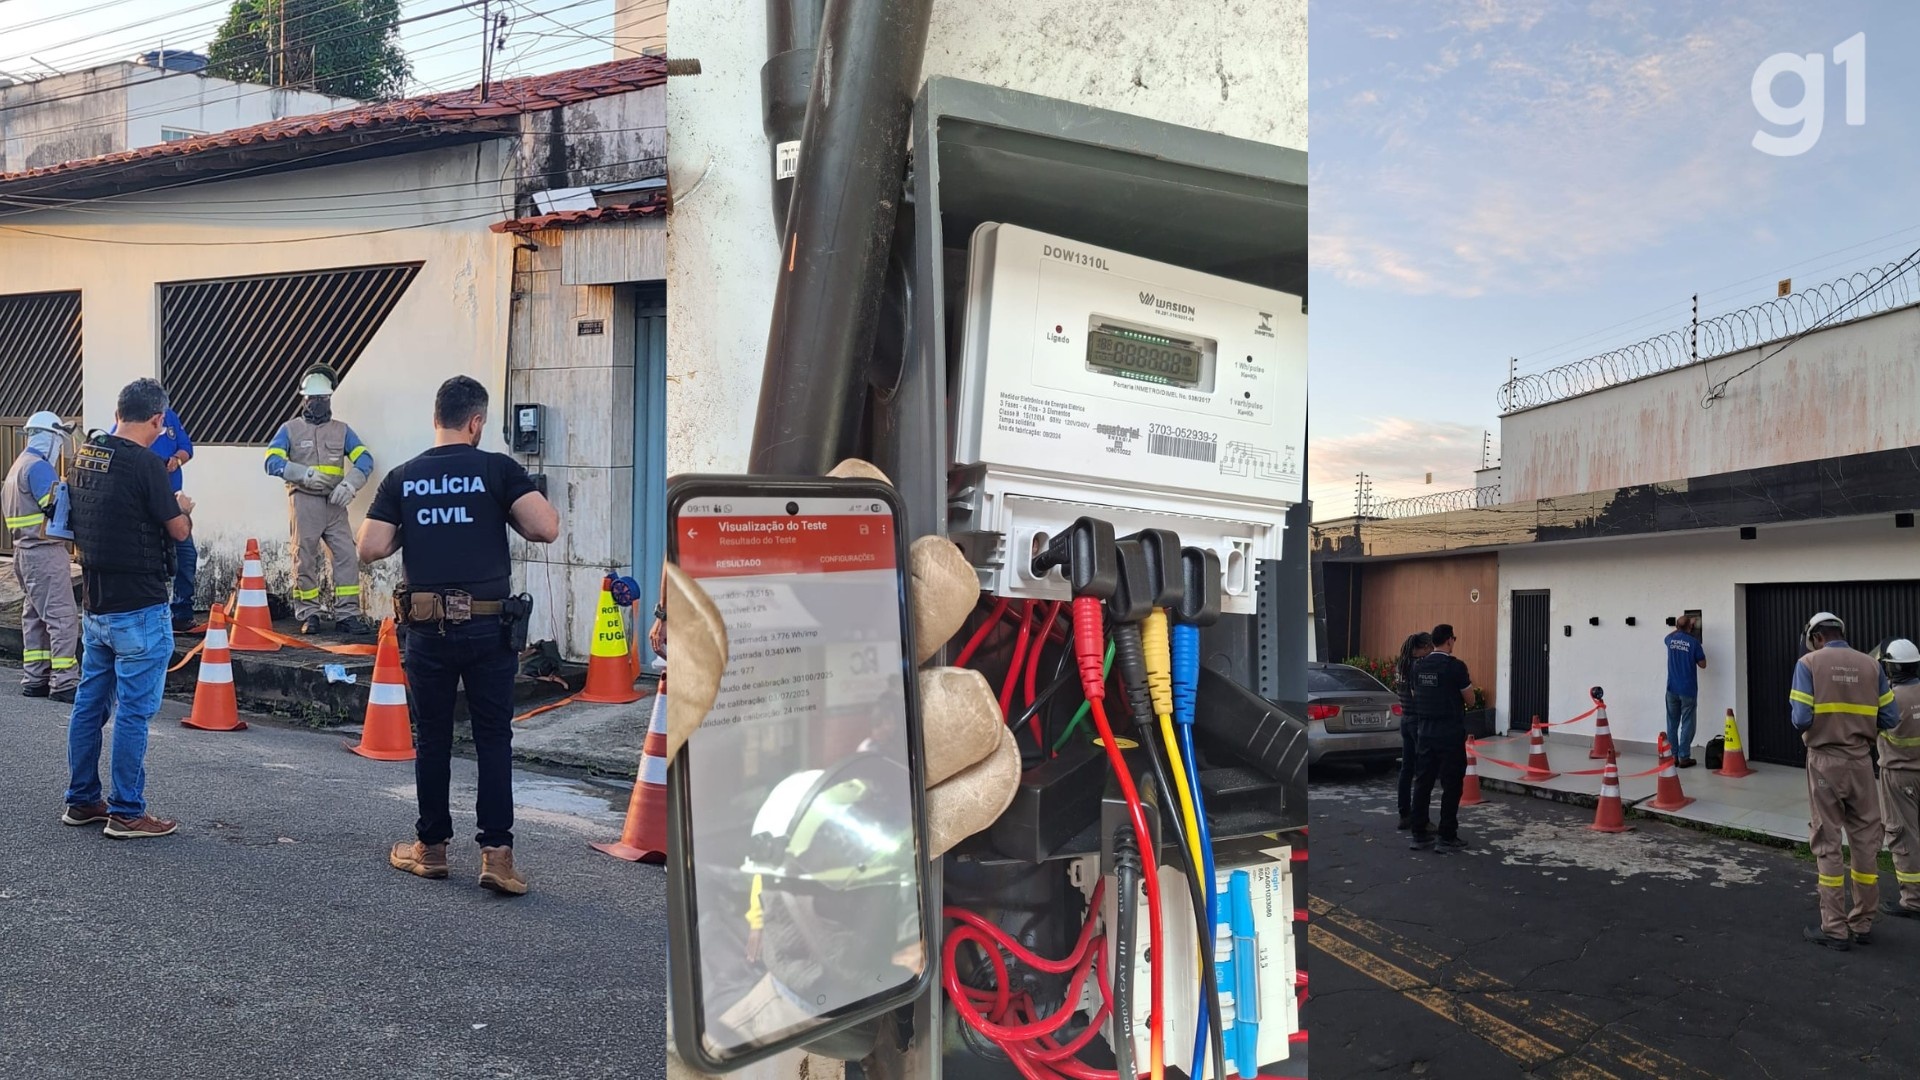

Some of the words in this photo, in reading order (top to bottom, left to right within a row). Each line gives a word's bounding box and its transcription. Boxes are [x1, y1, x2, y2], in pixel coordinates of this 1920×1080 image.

[1043, 244, 1110, 271] DOW1310L
[1155, 298, 1196, 316] WASION
[1046, 332, 1070, 344] Ligado
[1113, 380, 1134, 391] Portaria
[1000, 391, 1020, 401] Medidor
[1050, 400, 1068, 410] Energia
[999, 408, 1016, 417] Classe
[1005, 401, 1019, 409] Fases
[1047, 407, 1071, 418] Elementos
[998, 415, 1015, 425] Tampa
[998, 423, 1008, 431] Ano
[1148, 422, 1218, 443] 3703-052939-2
[403, 473, 486, 498] POLÍCIA
[687, 505, 710, 513] 09:11
[417, 506, 474, 525] CIVIL
[718, 521, 785, 534] Visualização
[786, 520, 799, 531] do
[801, 520, 828, 531] Teste
[719, 537, 761, 546] Resultado
[762, 536, 773, 545] do
[775, 535, 797, 544] Teste
[716, 558, 761, 569] RESULTADO
[820, 553, 875, 564] CONFIGURAÇÕES
[1670, 639, 1690, 647] PERÍCIA
[1670, 644, 1690, 652] OFICIAL
[727, 650, 763, 662] egistrada:
[785, 645, 802, 654] kWh
[740, 666, 755, 675] 977
[741, 682, 752, 691] de
[752, 677, 790, 690] calibração:
[716, 702, 726, 710] de
[727, 696, 767, 709] calibração:
[783, 705, 793, 715] 24
[793, 704, 817, 713] meses
[1271, 868, 1279, 891] elgin
